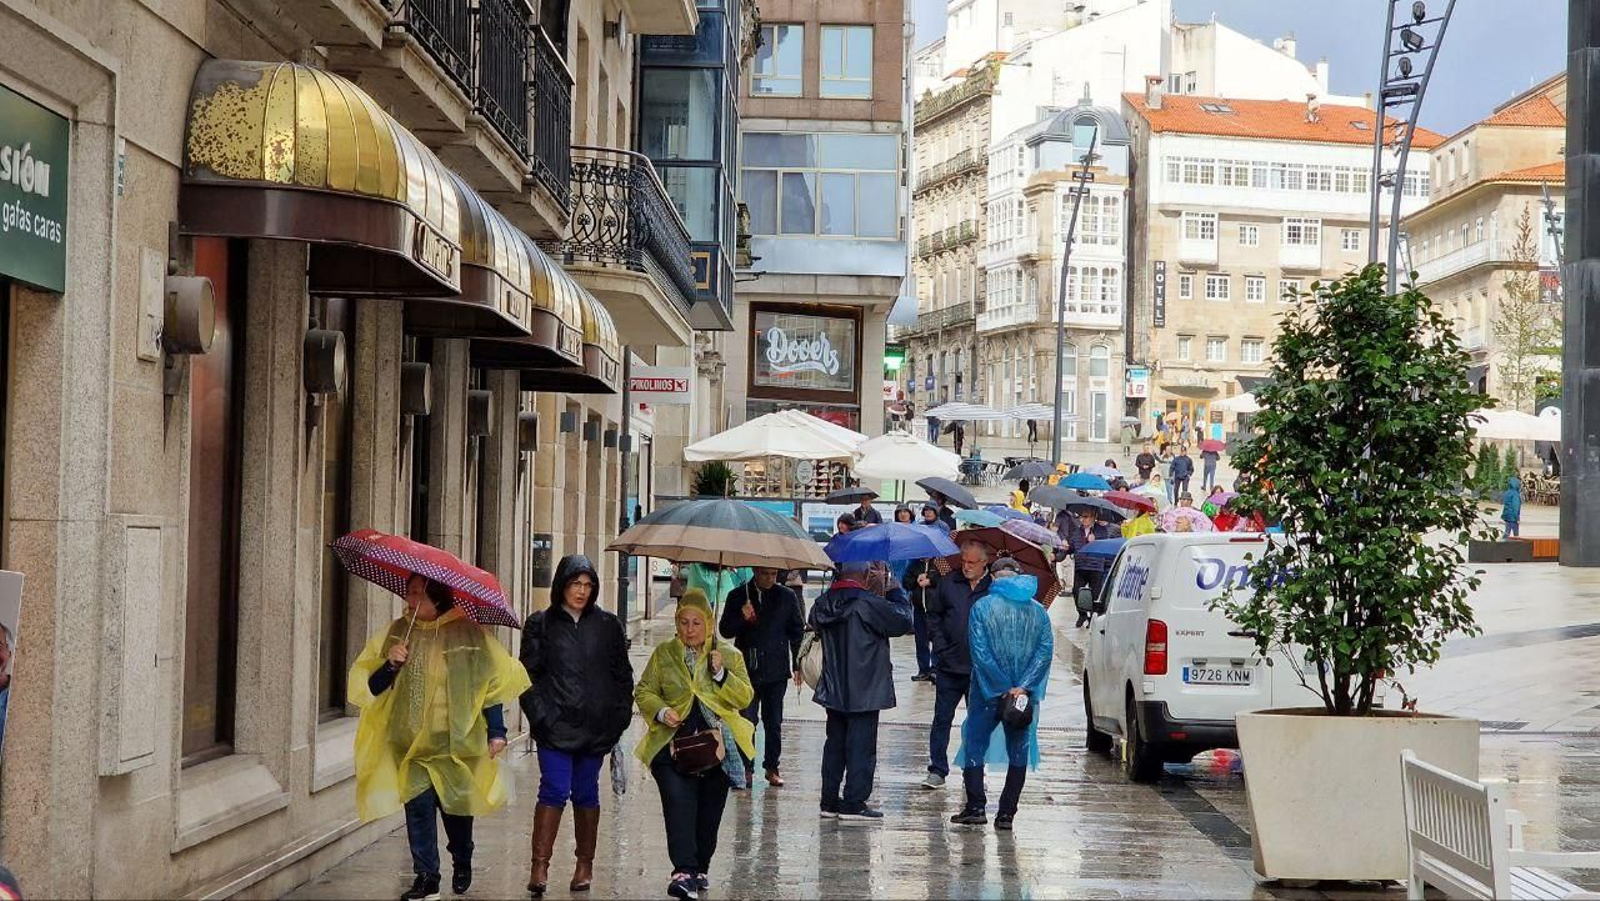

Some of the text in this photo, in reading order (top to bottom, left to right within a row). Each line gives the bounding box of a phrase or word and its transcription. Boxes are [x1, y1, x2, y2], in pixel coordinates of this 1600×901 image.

[3, 200, 61, 243] gafas caras
[1156, 262, 1164, 318] HOTEL
[630, 379, 673, 390] PIKOLINOS
[1191, 669, 1250, 681] 9726 KNM
